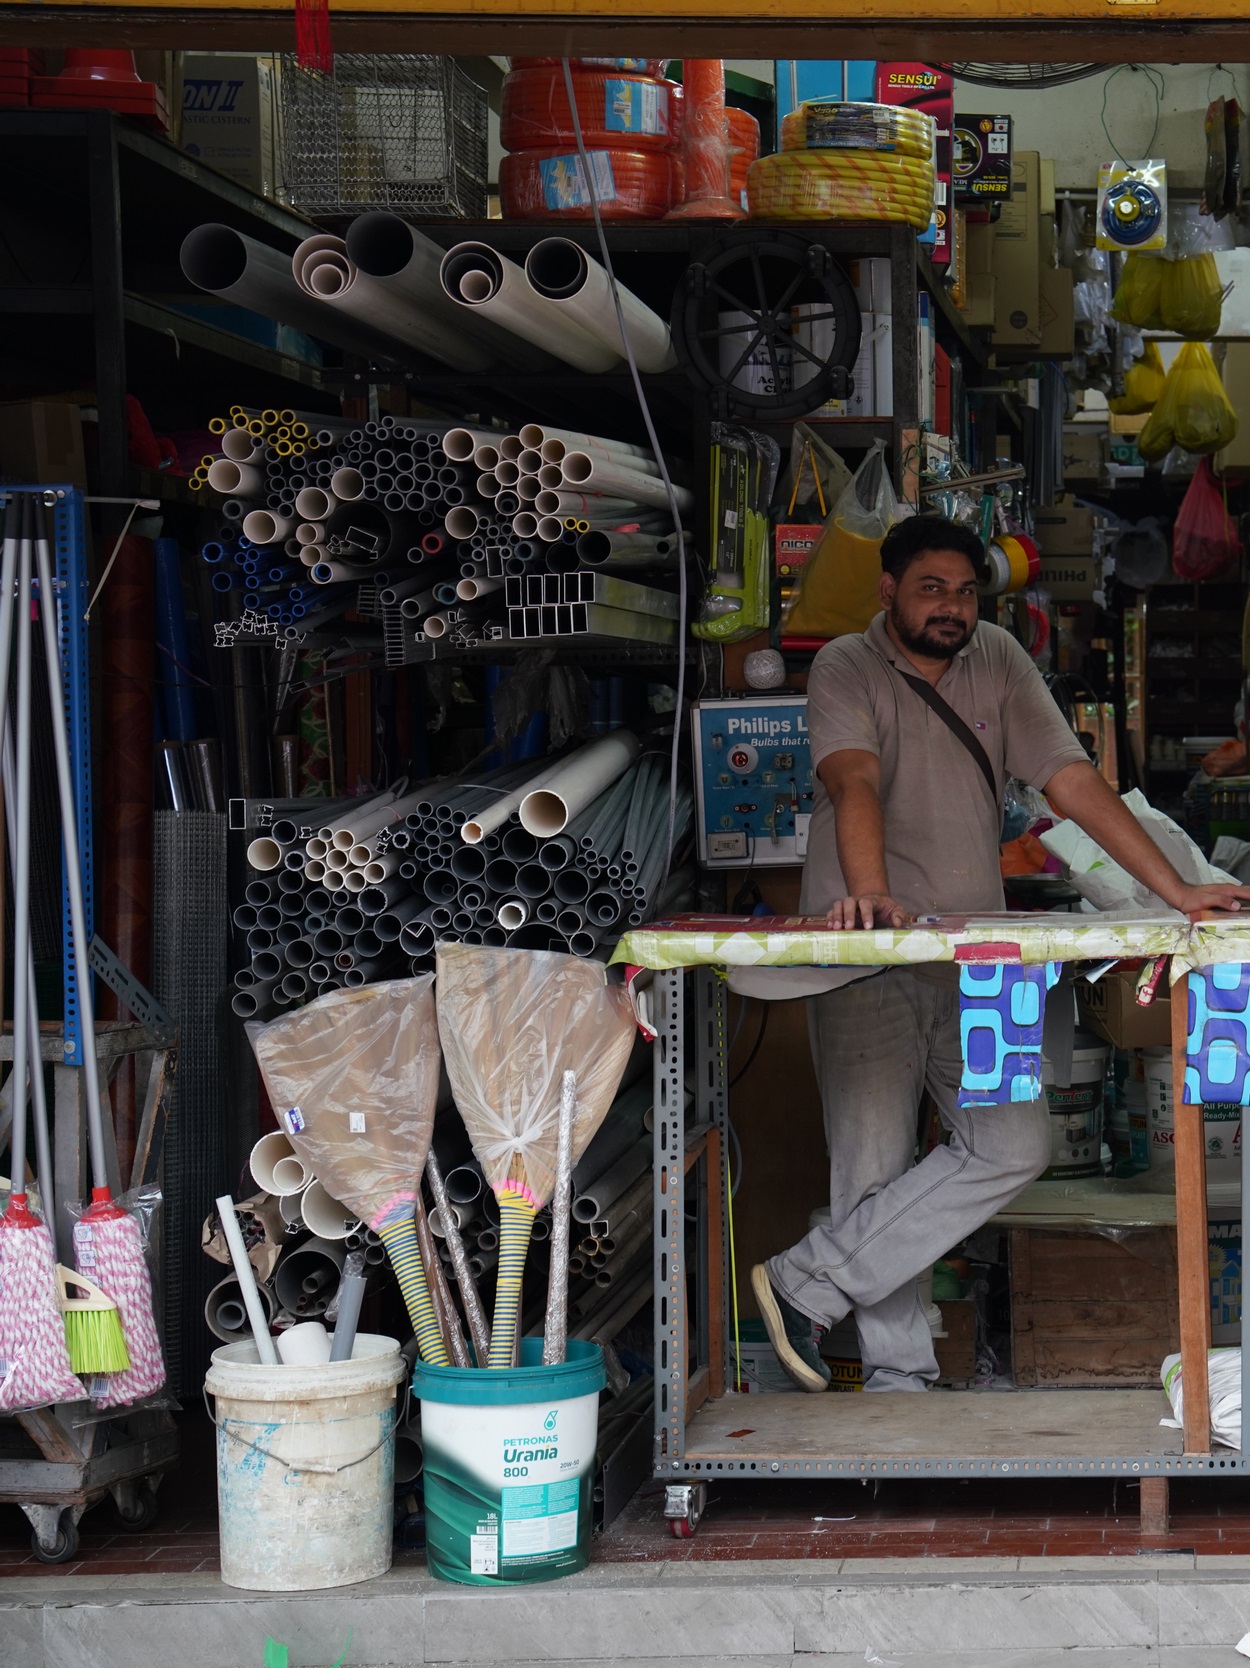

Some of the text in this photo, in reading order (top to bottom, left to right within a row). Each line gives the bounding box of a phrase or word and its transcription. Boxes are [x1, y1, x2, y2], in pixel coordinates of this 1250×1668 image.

[889, 73, 937, 85] SENSUI
[211, 116, 251, 124] CISTERN
[973, 183, 1007, 192] SENSUI
[728, 717, 791, 736] Philips
[750, 738, 779, 747] Bulbs
[782, 737, 801, 746] that
[503, 1434, 558, 1447] PETRONAS
[503, 1444, 558, 1463] Urania
[560, 1459, 580, 1468] 20W-50
[503, 1466, 529, 1478] 800
